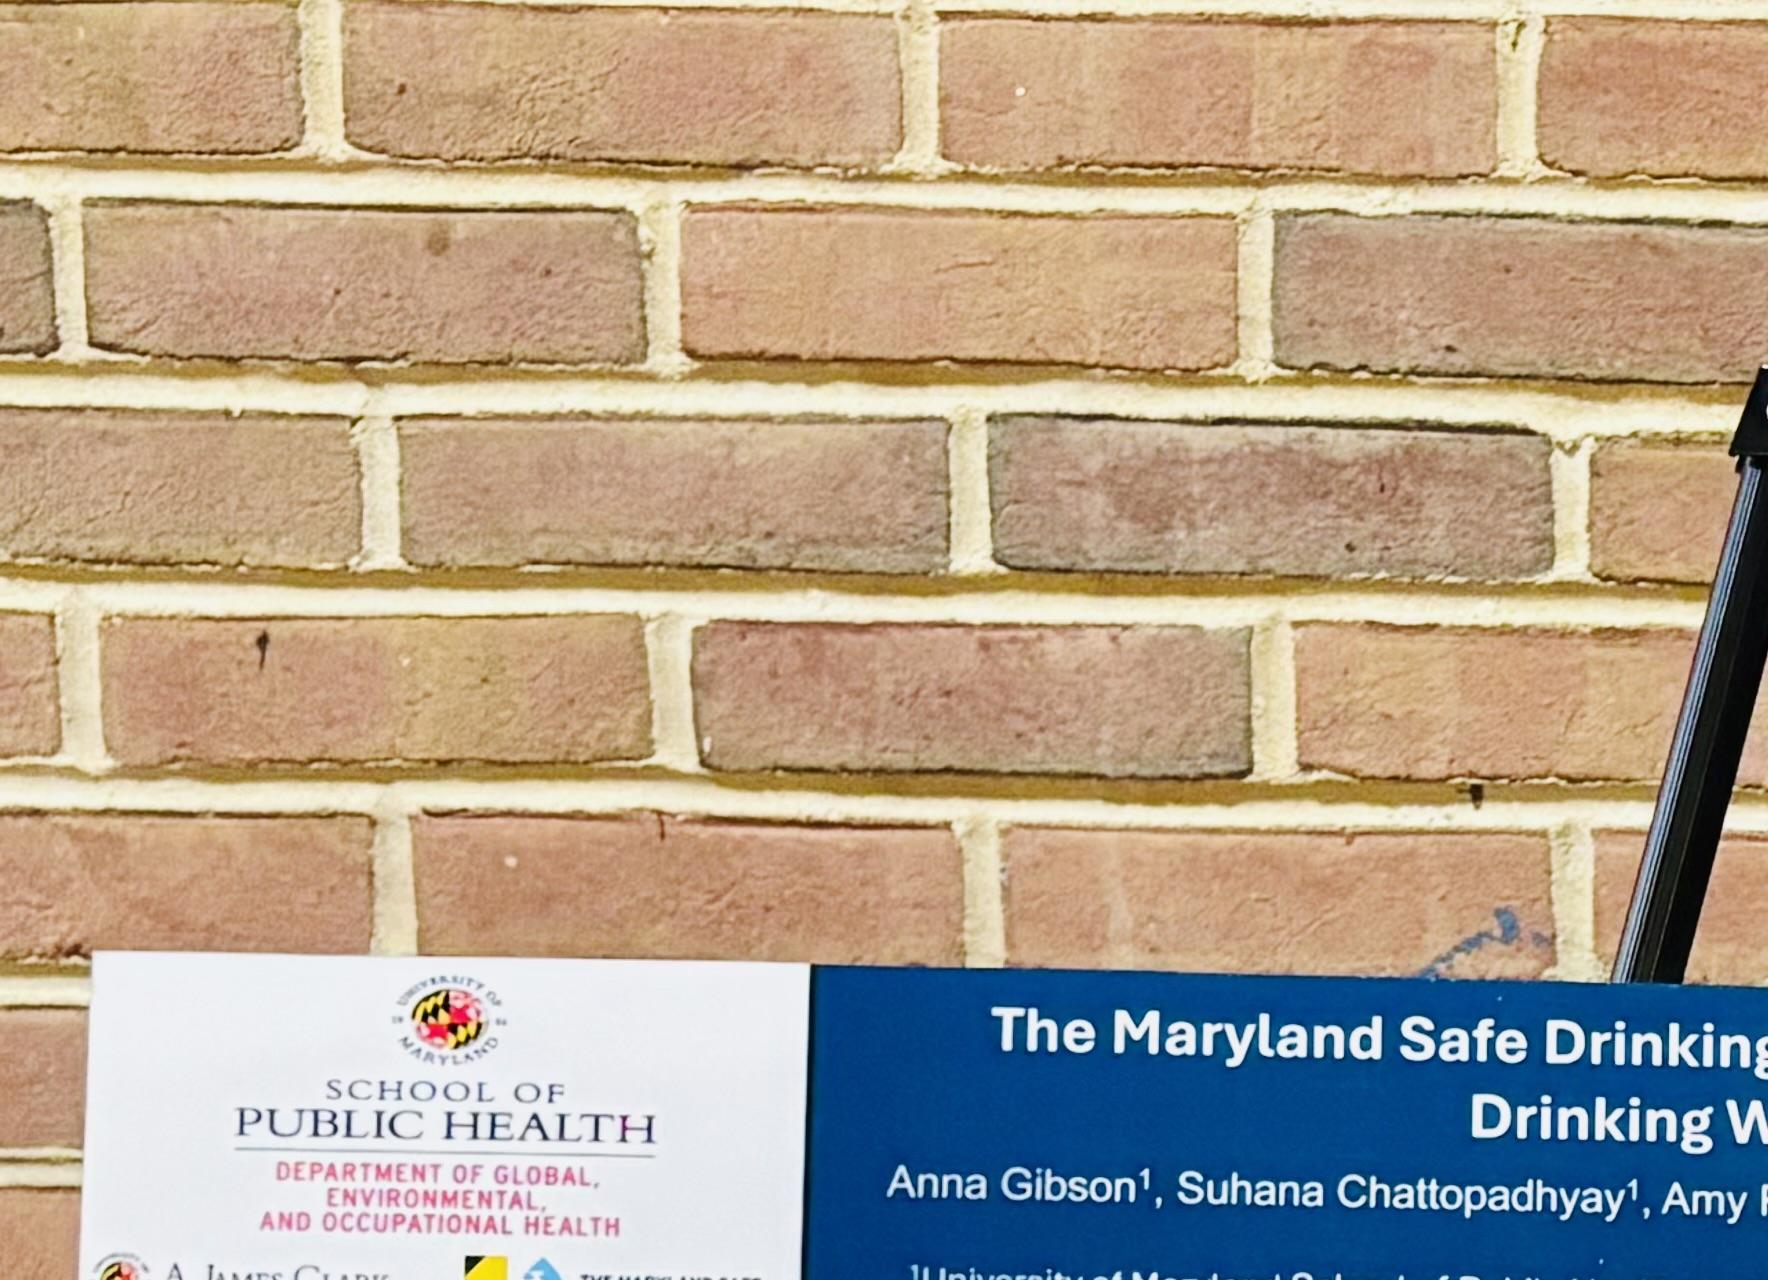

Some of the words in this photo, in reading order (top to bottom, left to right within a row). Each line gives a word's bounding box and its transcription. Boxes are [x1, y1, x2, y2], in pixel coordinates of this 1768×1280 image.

[990, 1006, 1096, 1054] The
[1113, 1009, 1383, 1068] Maryland
[1399, 1015, 1528, 1064] Safe
[326, 1079, 495, 1103] SCHOOL
[513, 1082, 565, 1104] OF
[237, 1107, 423, 1140] PUBLIC
[444, 1111, 654, 1144] HEALTH
[1471, 1093, 1714, 1155] Drinking
[275, 1161, 442, 1183] DEPARTMENT
[451, 1163, 485, 1185] OF
[492, 1164, 599, 1190] GLOBAL,
[327, 1187, 547, 1213] ENVIRONMENTAL,
[886, 1164, 988, 1200] Anna
[1177, 1170, 1324, 1207] Suhana
[1661, 1181, 1748, 1225] Amy
[259, 1211, 312, 1233] AND
[321, 1211, 513, 1236] OCCUPATIONAL
[523, 1215, 621, 1237] HEALTH
